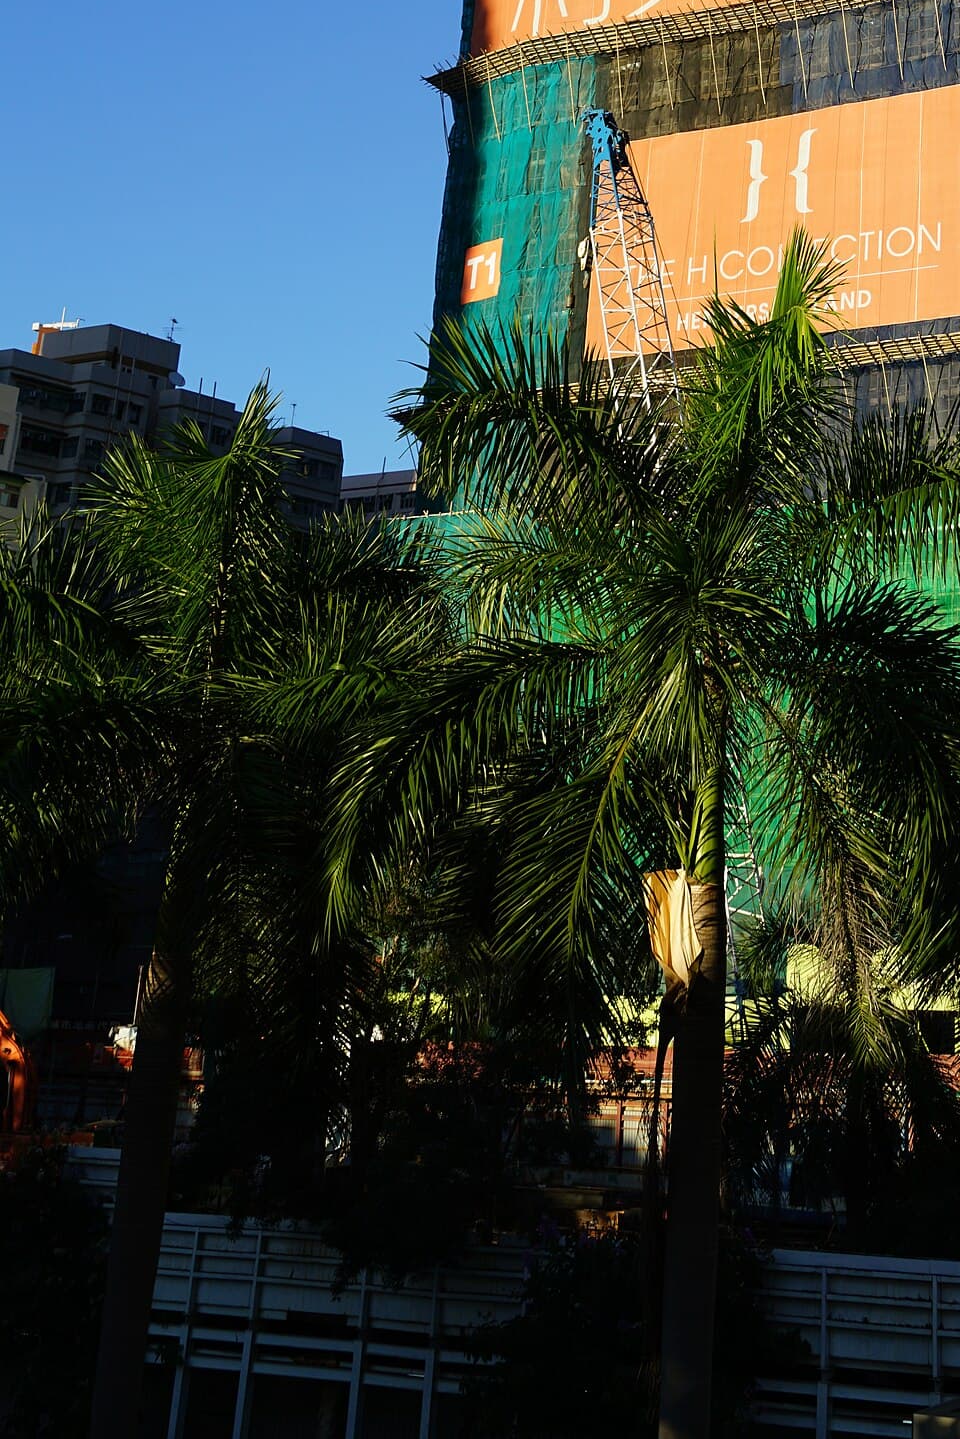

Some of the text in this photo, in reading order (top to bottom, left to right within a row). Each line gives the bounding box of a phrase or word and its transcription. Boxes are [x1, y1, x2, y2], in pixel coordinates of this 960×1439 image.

[467, 251, 497, 290] T1
[687, 255, 708, 285] H
[719, 221, 942, 280] COLECTION
